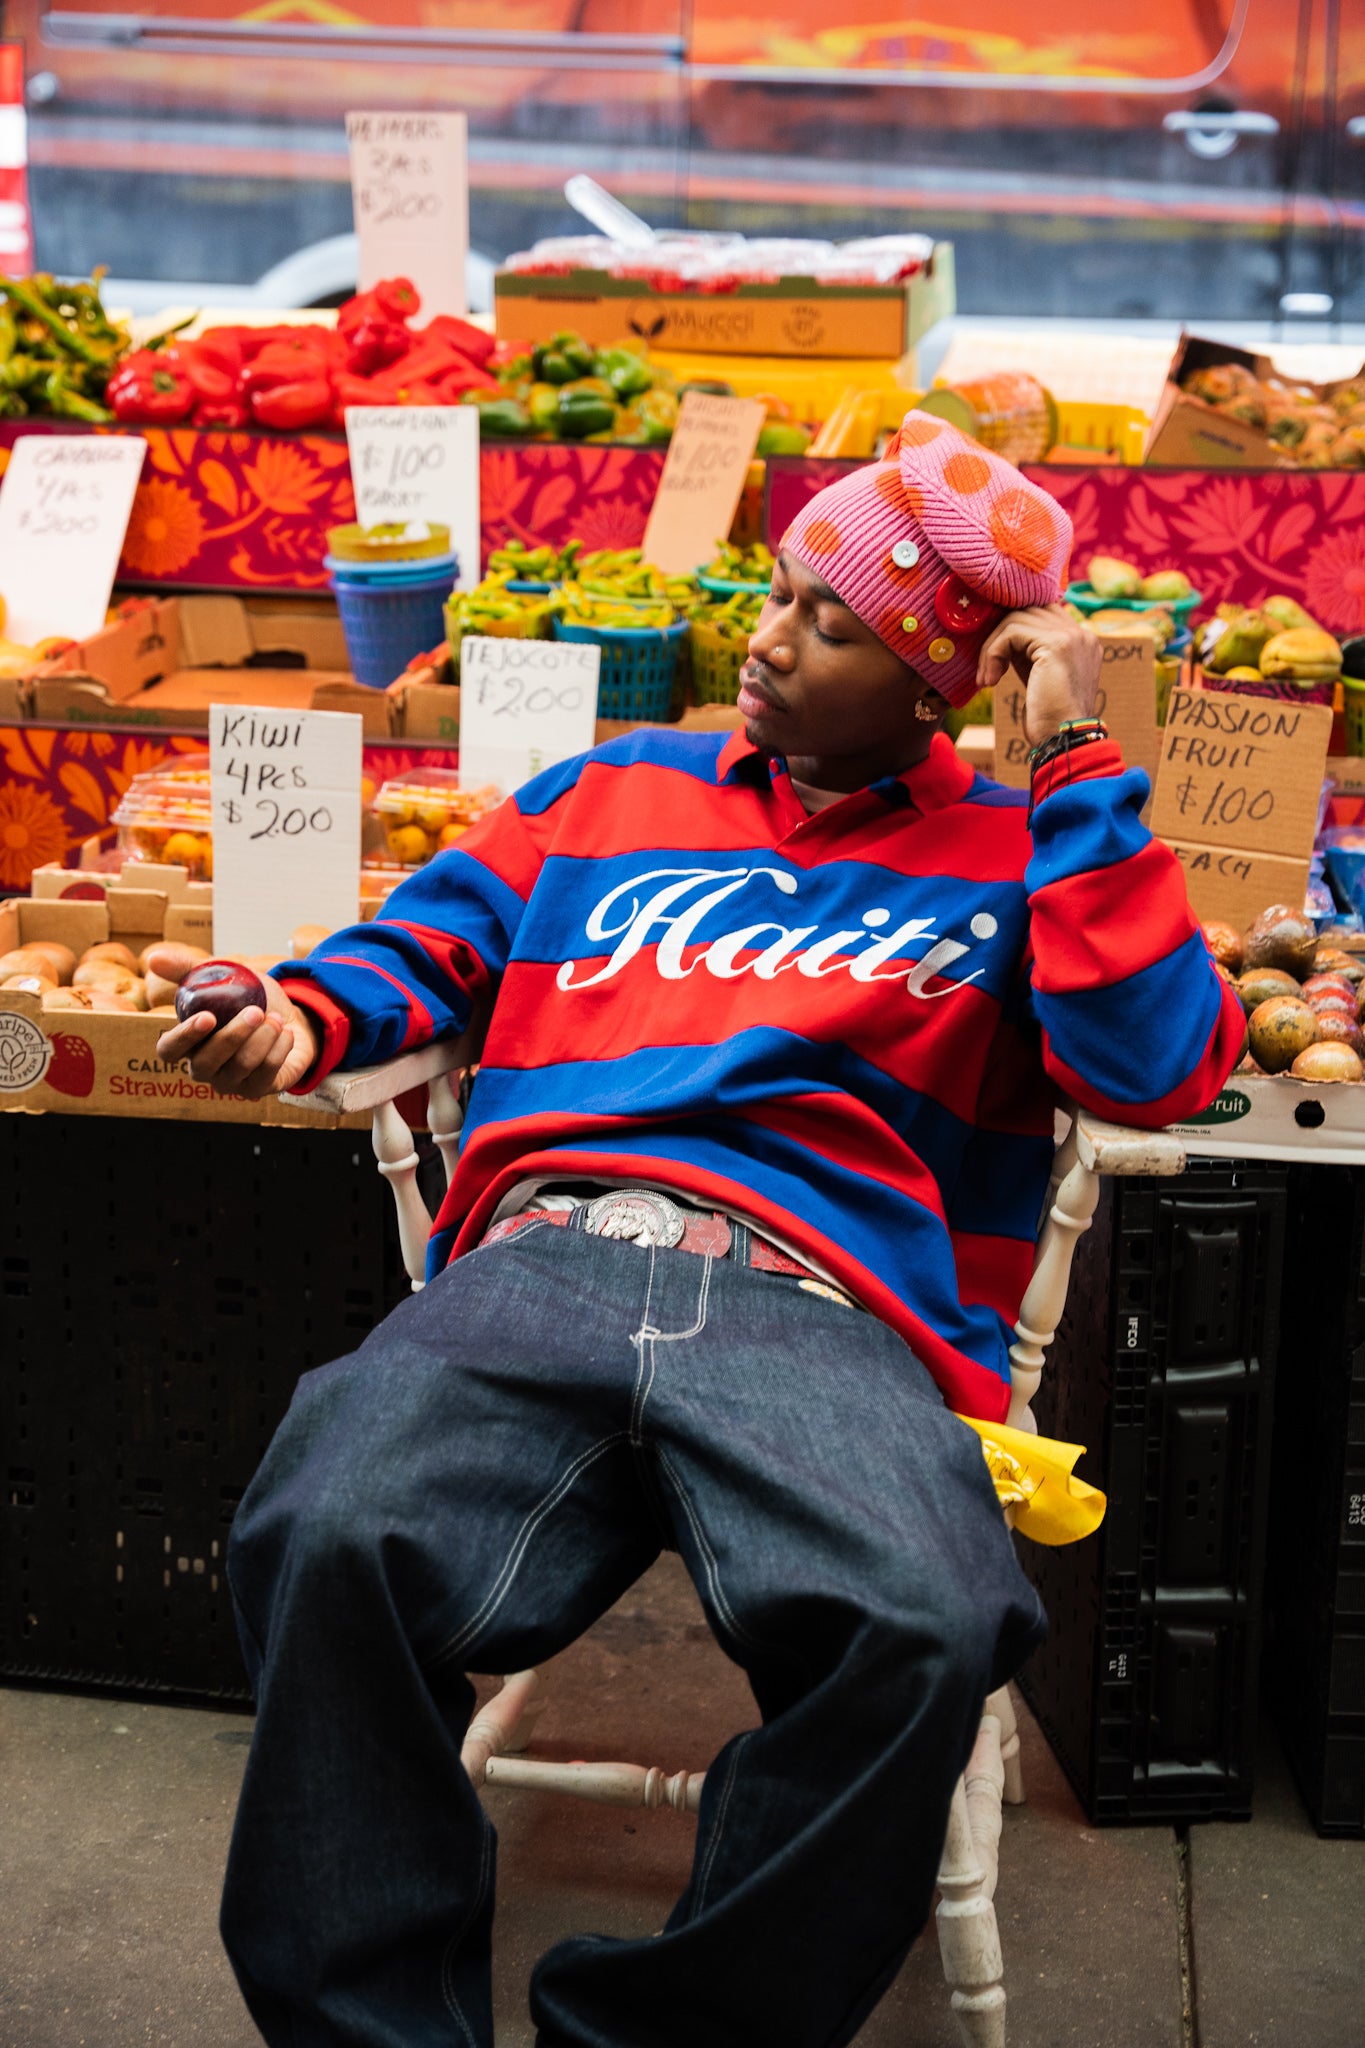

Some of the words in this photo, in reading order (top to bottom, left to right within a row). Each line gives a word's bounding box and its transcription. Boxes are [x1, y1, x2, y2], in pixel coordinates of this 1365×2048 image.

[465, 641, 595, 672] TEJOCOTE
[1169, 692, 1301, 738] PASSION
[1167, 736, 1272, 769] FRUIT
[555, 867, 998, 999] Haiti
[1209, 1097, 1244, 1114] ruit
[1127, 1316, 1139, 1348] IFCO
[1348, 1494, 1362, 1525] 6413
